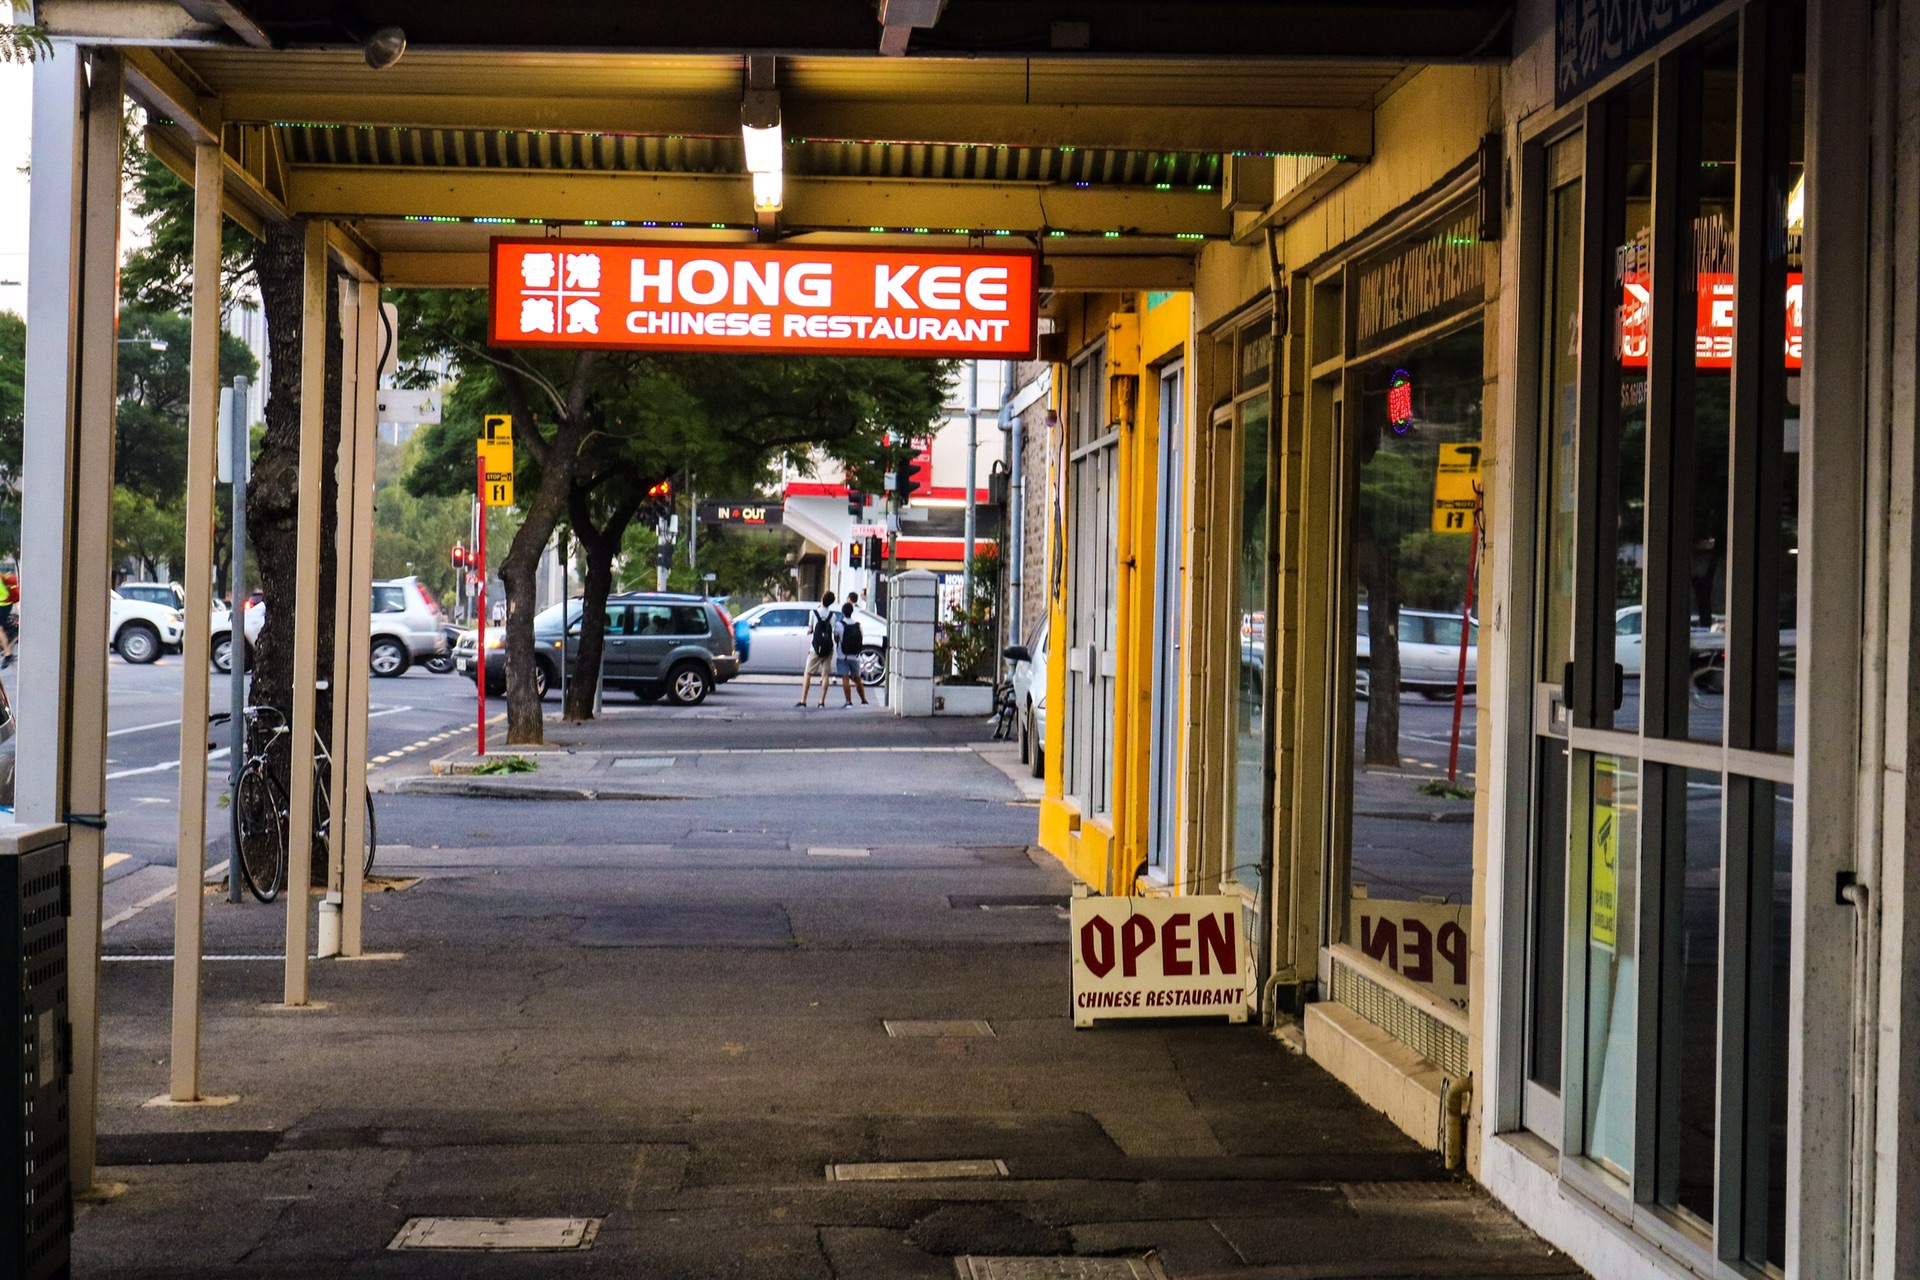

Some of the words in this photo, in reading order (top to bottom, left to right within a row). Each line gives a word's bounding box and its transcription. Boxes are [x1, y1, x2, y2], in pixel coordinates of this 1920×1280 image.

[520, 252, 601, 290] 香港
[629, 258, 833, 308] HONG
[875, 264, 1009, 312] KEE
[1382, 255, 1401, 331] KEE
[1402, 232, 1443, 321] CHINESE
[519, 297, 600, 335] 美食
[626, 309, 771, 338] CHINESE
[783, 312, 1010, 343] RESTAURANT
[493, 484, 505, 501] F1
[718, 507, 730, 519] IN
[742, 508, 766, 520] OUT
[1080, 912, 1237, 980] OPEN
[1077, 991, 1141, 1009] CHINESE
[1145, 987, 1245, 1007] RESTAURANT
